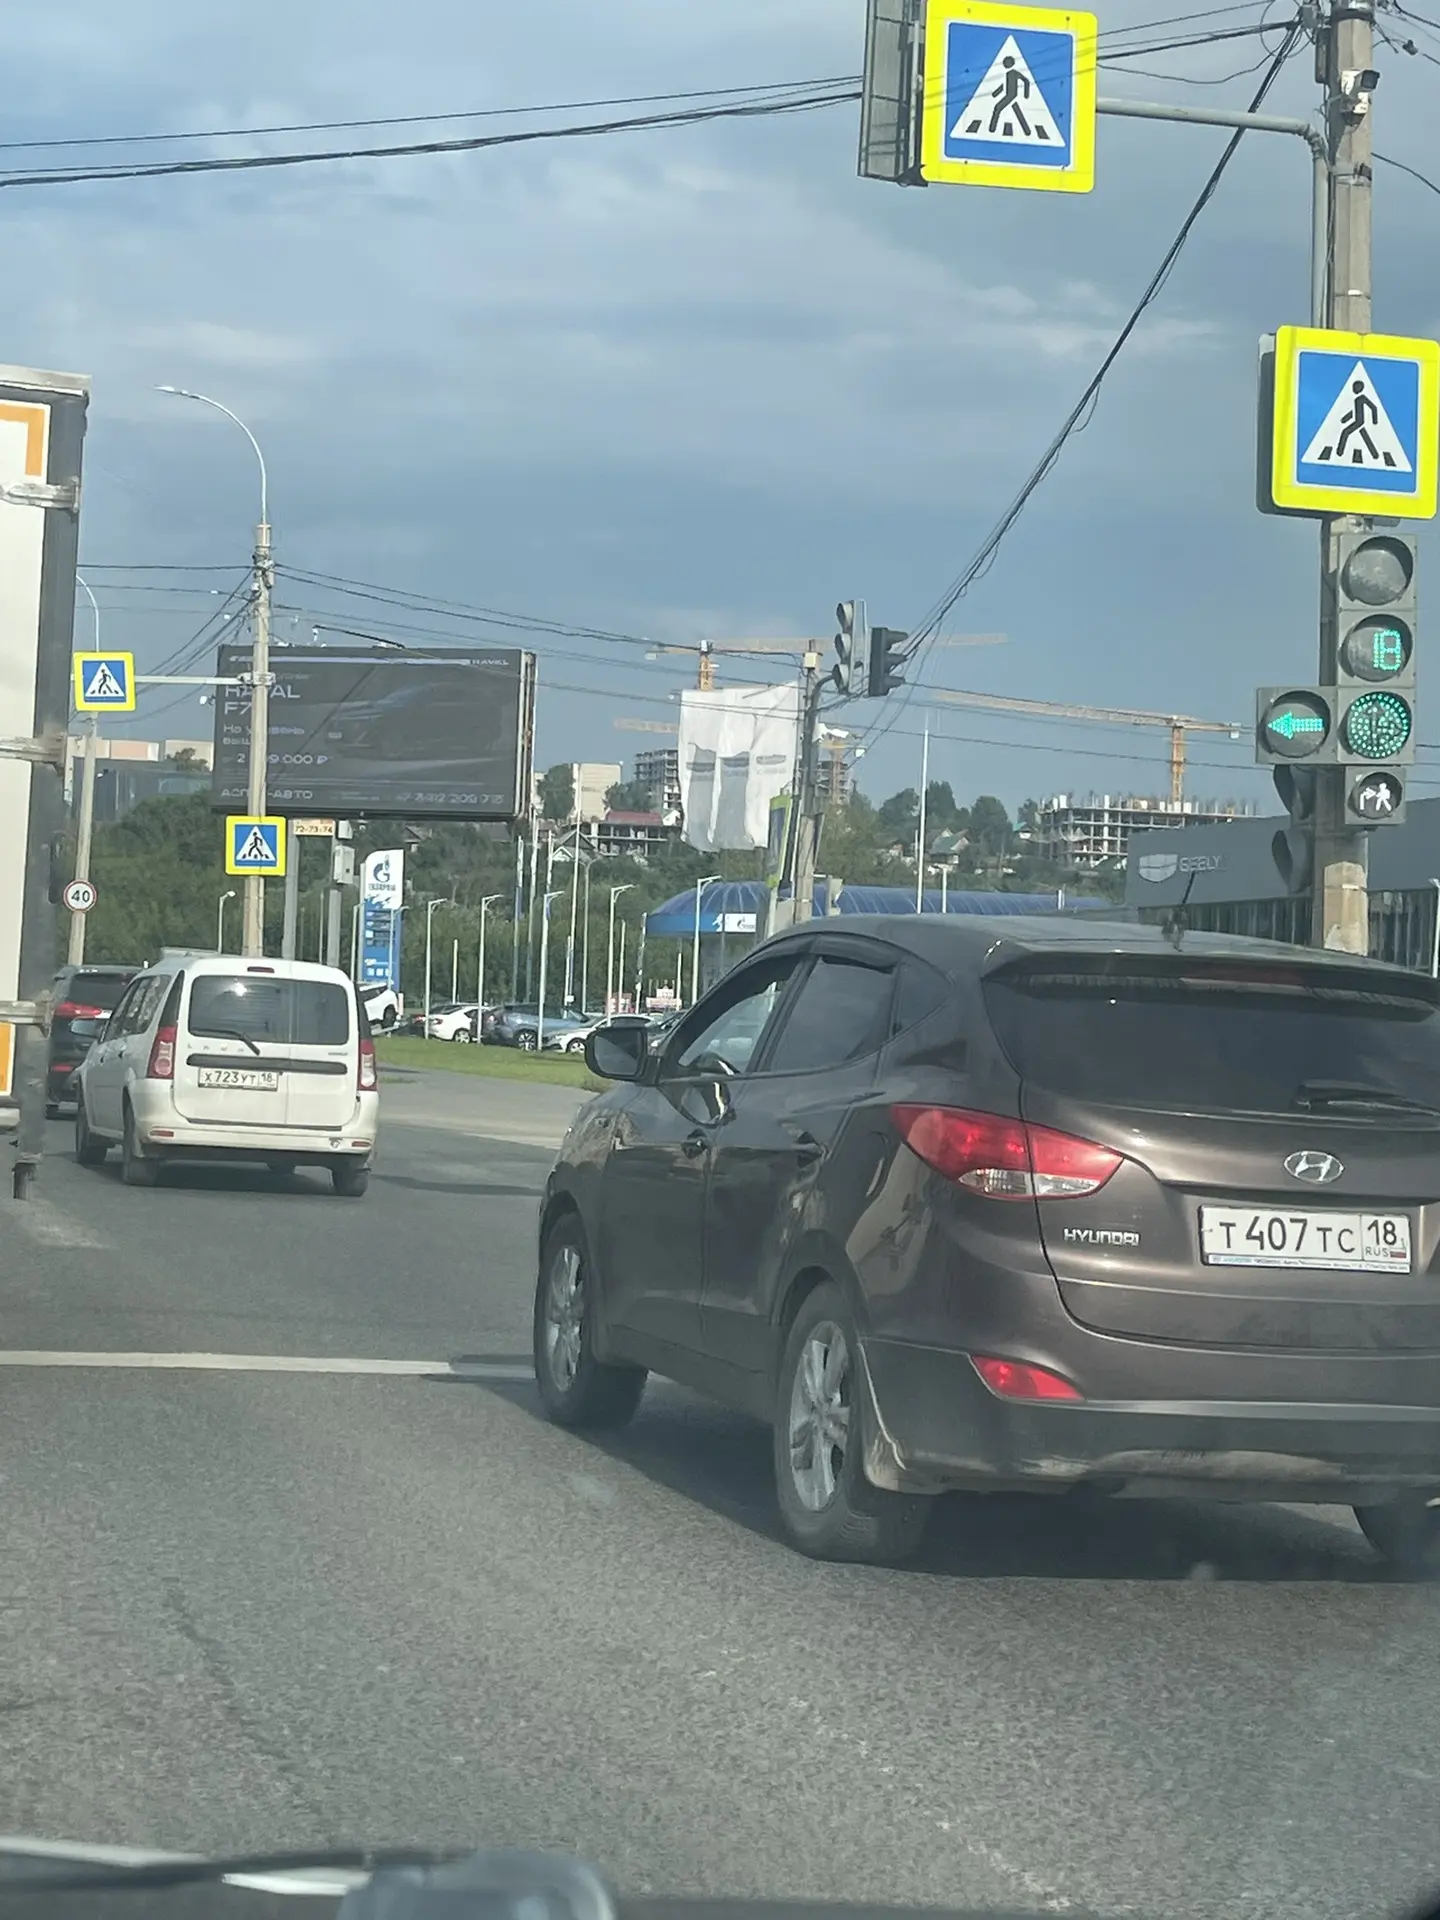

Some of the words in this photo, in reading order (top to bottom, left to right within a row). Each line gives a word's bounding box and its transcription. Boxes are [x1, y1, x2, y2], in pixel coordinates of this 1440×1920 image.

[1373, 629, 1401, 670] 18
[224, 684, 301, 699] HAAL
[224, 702, 252, 715] F7
[221, 787, 313, 800] АСП-АВТО
[71, 890, 90, 902] 40
[261, 1072, 274, 1083] 18
[1063, 1228, 1140, 1246] HYUNDAI
[1367, 1219, 1397, 1246] 18
[1365, 1246, 1389, 1257] RUS
